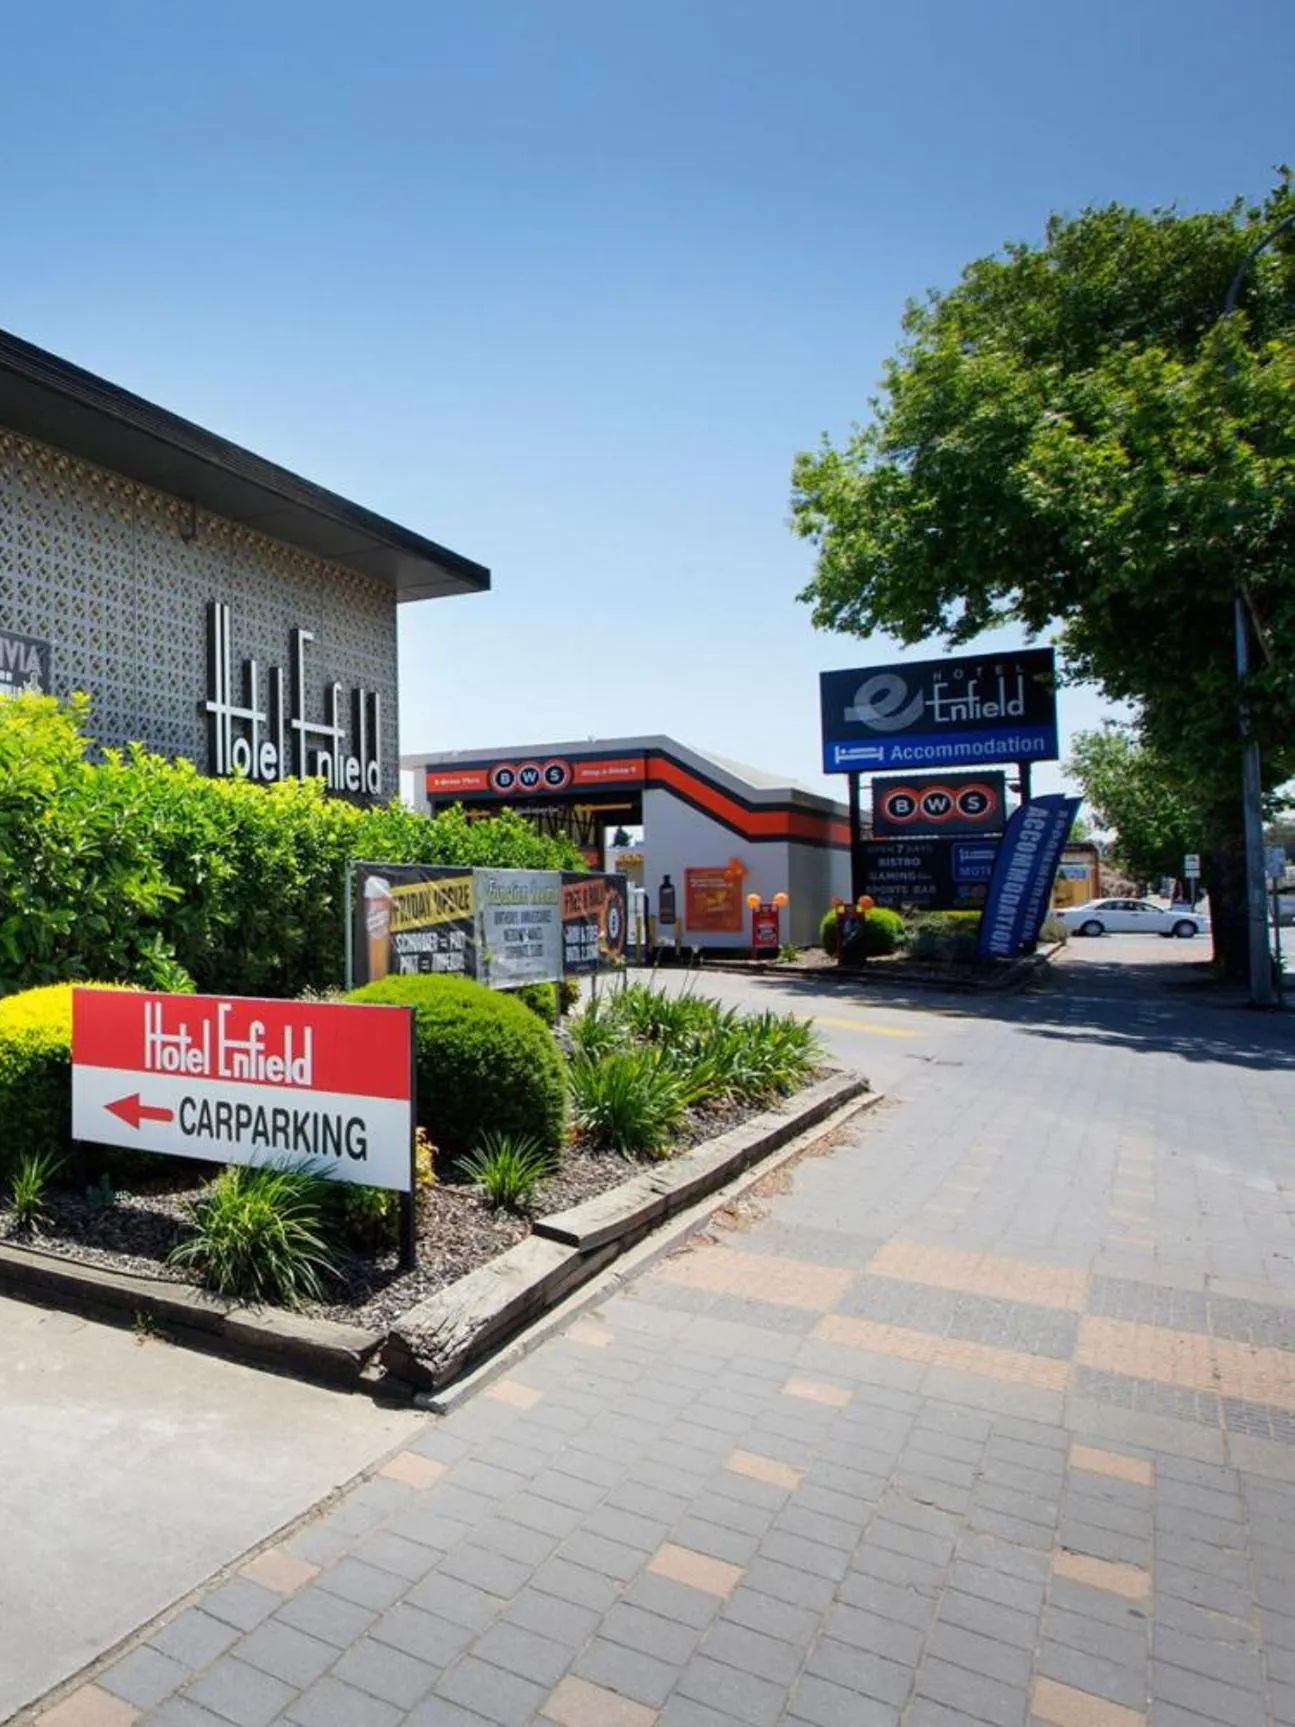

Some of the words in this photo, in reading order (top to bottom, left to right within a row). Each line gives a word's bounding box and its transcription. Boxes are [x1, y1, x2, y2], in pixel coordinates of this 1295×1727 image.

[206, 602, 284, 781] Hotel
[933, 664, 1024, 681] HOTEL
[925, 674, 1025, 723] Enfield
[890, 736, 1046, 762] Accommodation
[868, 871, 917, 882] GAMING
[877, 856, 923, 868] BISTRO
[988, 805, 1049, 954] ACCOMMODATION
[144, 1001, 210, 1076] Hotel
[217, 1003, 313, 1086] Enfield
[179, 1096, 367, 1162] CARPARKING
